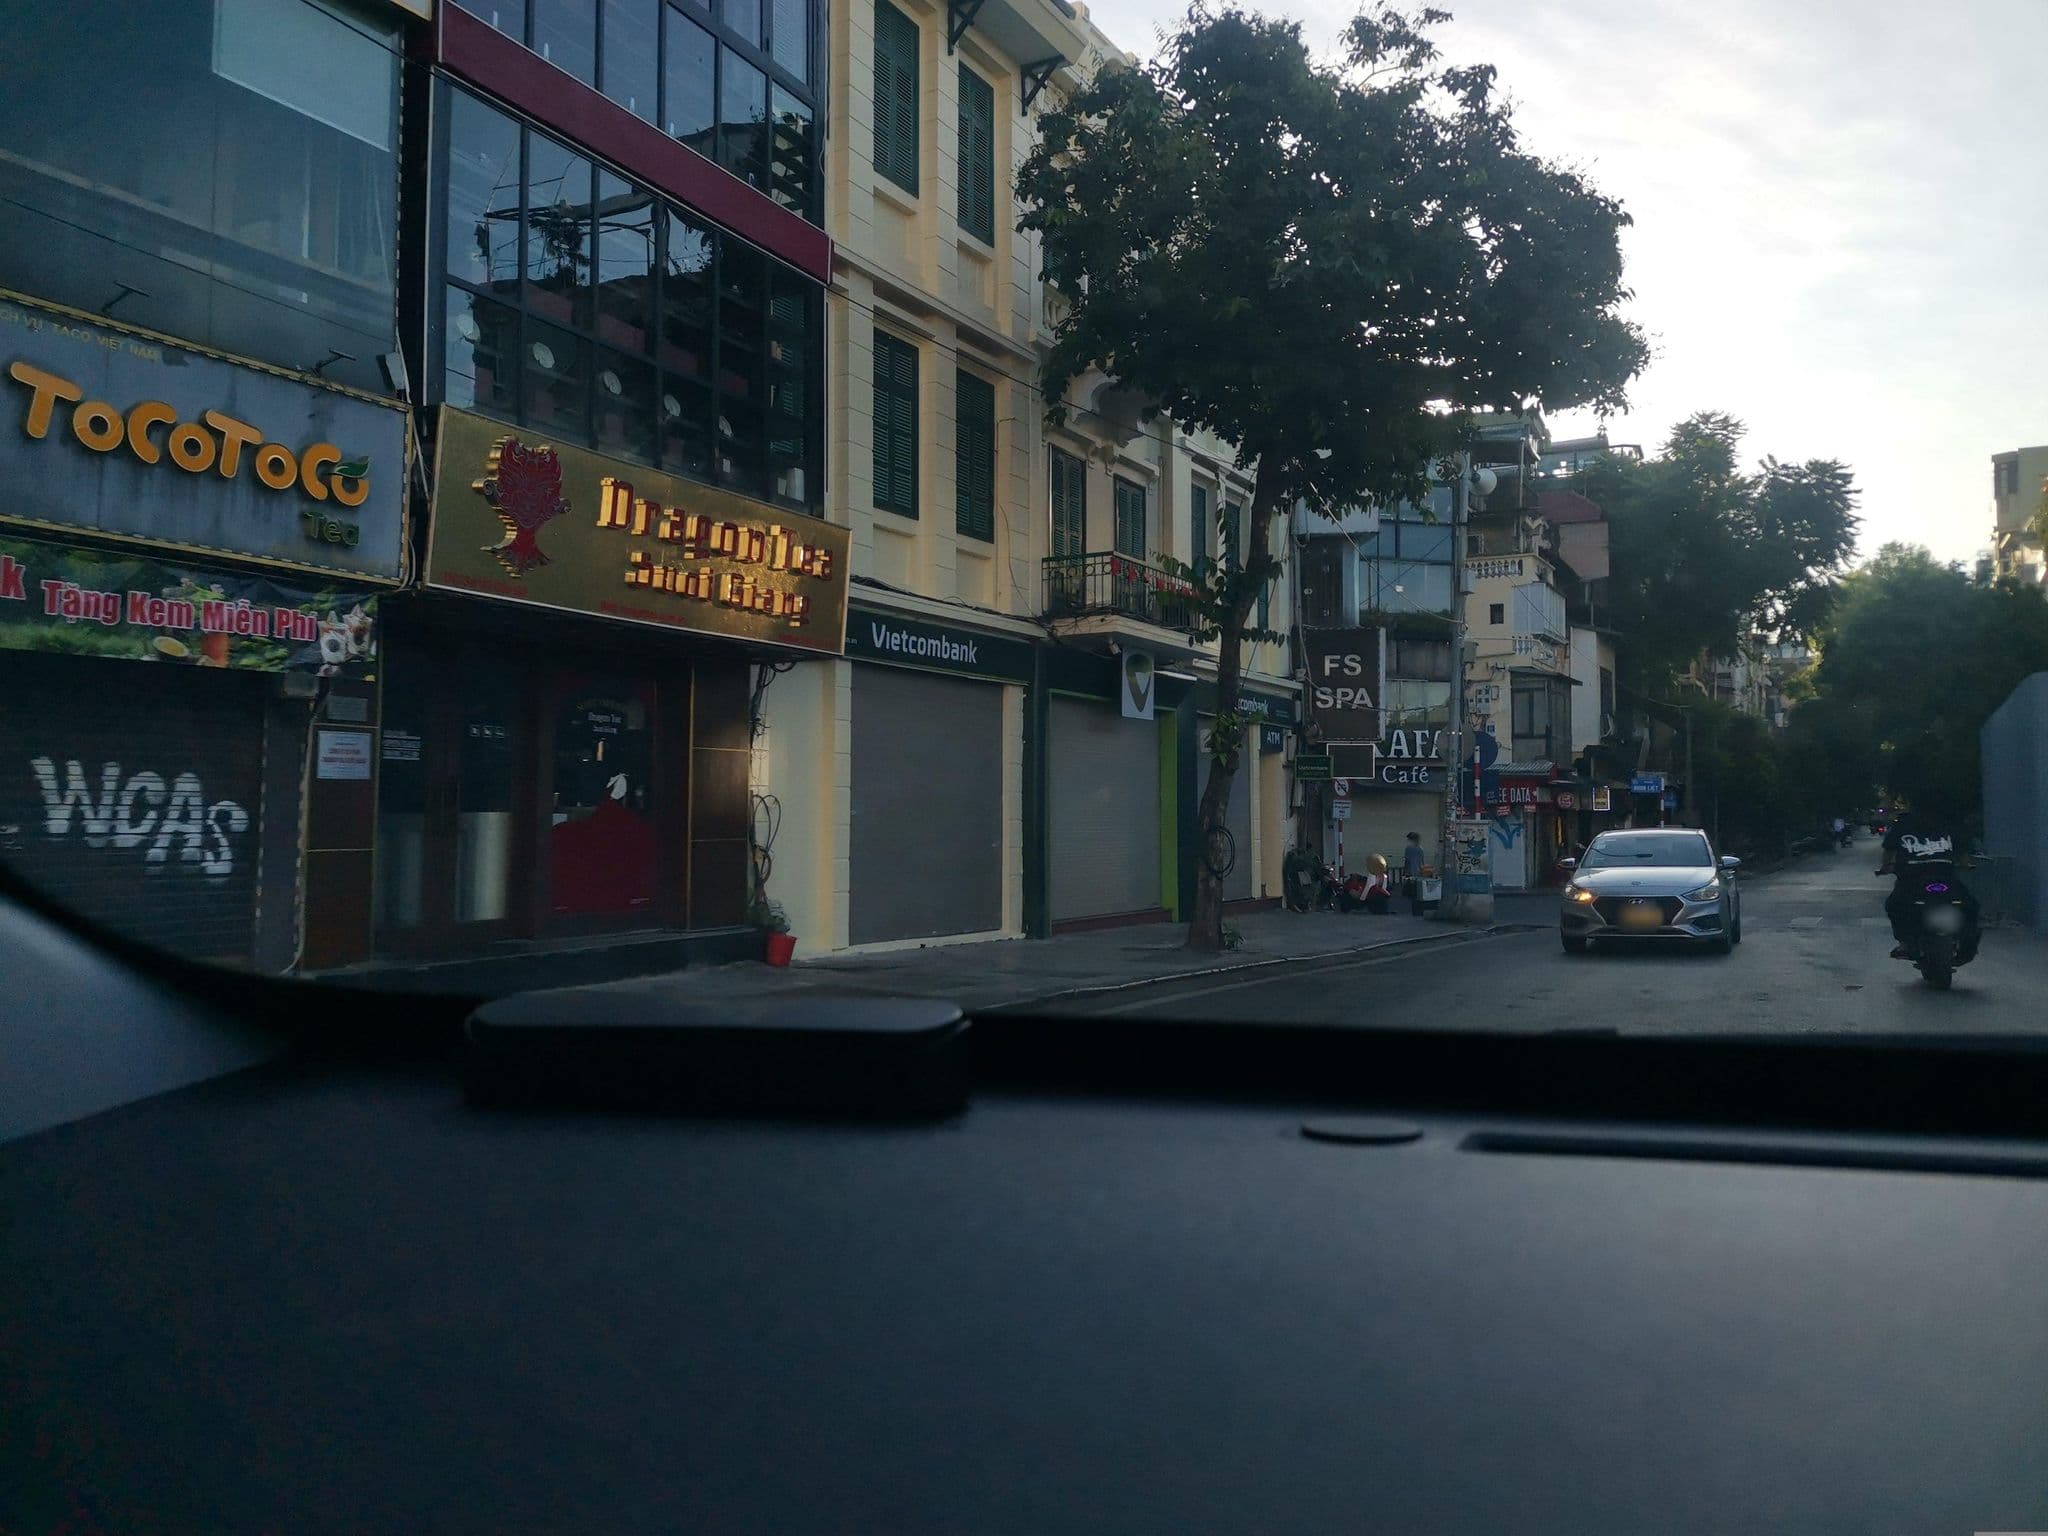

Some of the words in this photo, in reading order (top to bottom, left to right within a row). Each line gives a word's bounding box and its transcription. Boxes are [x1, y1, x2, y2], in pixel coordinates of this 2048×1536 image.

[304, 511, 360, 547] Tea
[41, 579, 122, 626] Tặng
[127, 590, 194, 630] Kem
[202, 598, 270, 638] Miễn
[872, 621, 978, 664] Vietcombank
[1324, 654, 1362, 677] FS
[1315, 687, 1373, 709] SPA
[1267, 730, 1281, 745] ATM
[1382, 764, 1430, 784] Café
[1510, 787, 1531, 803] DATA
